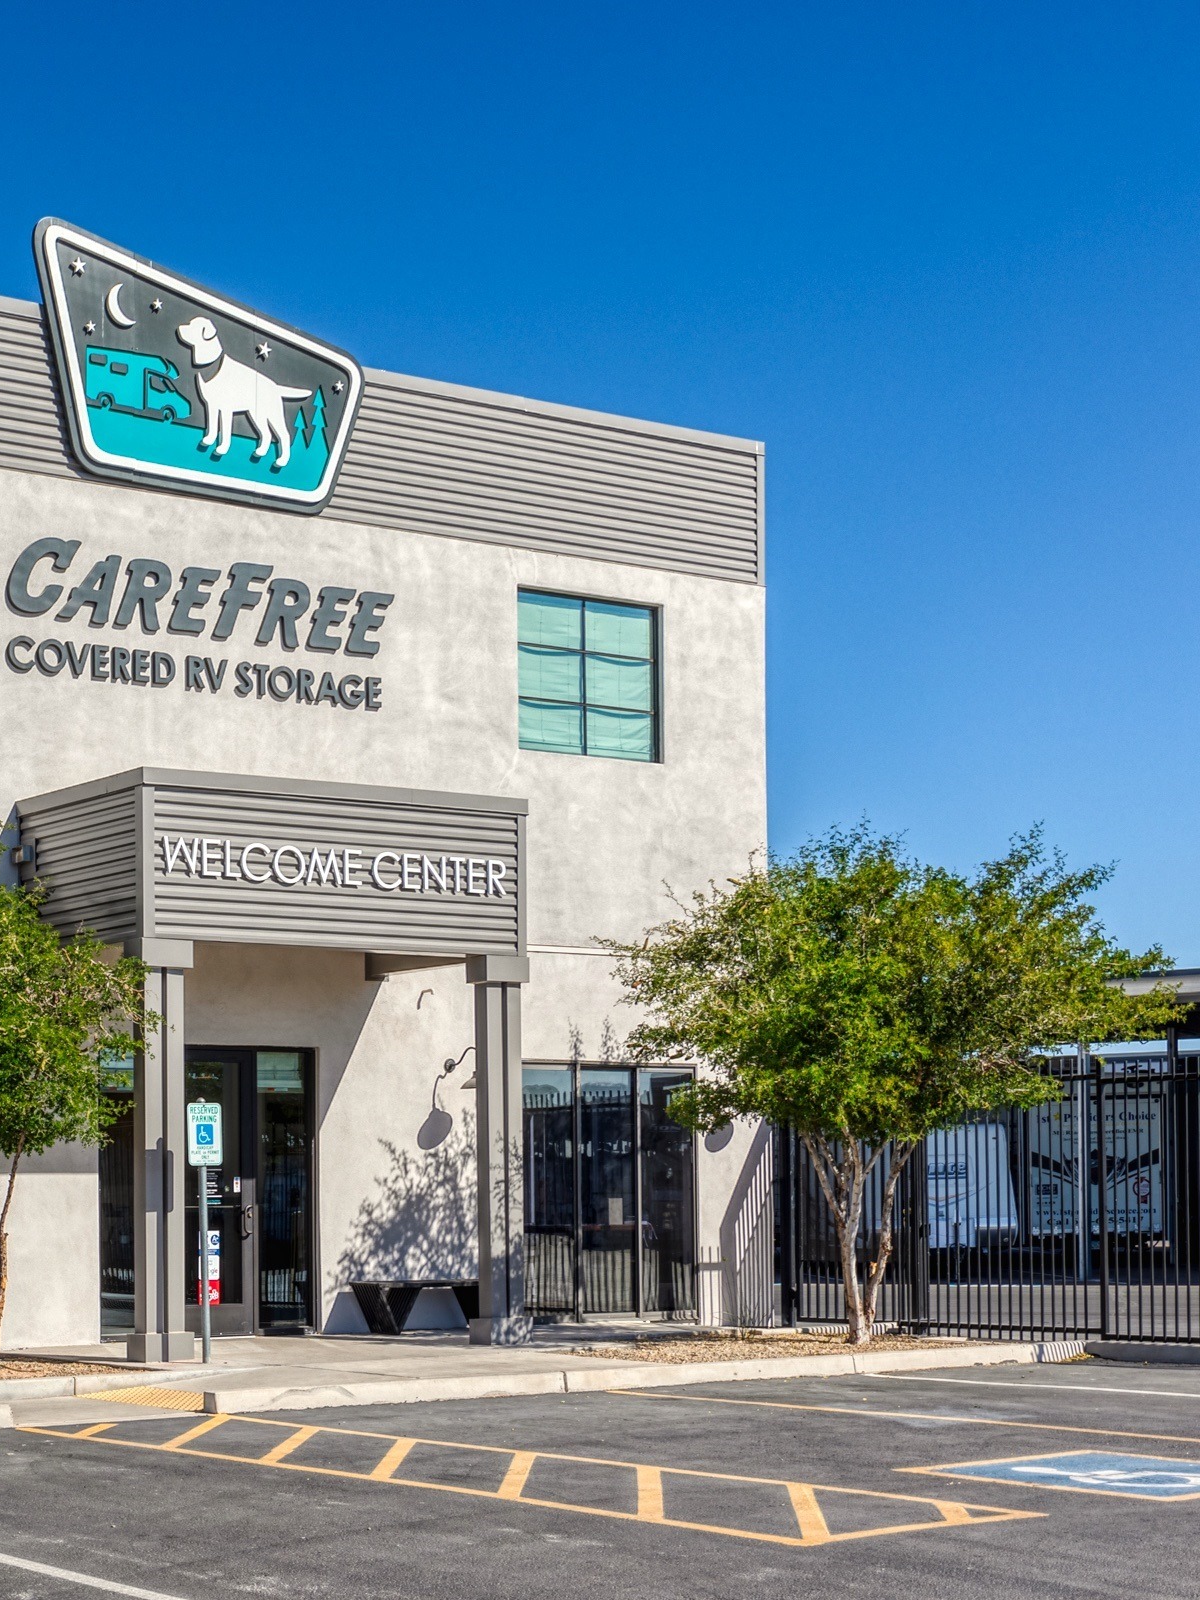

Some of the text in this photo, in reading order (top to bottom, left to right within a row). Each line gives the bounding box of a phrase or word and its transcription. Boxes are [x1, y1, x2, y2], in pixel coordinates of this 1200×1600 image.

[4, 536, 395, 658] CAREFREE
[5, 635, 382, 711] COVERED RV STORAGE
[161, 835, 507, 898] WELCOME CENTER
[190, 1106, 219, 1114] RESERVED
[192, 1115, 217, 1123] PARKING
